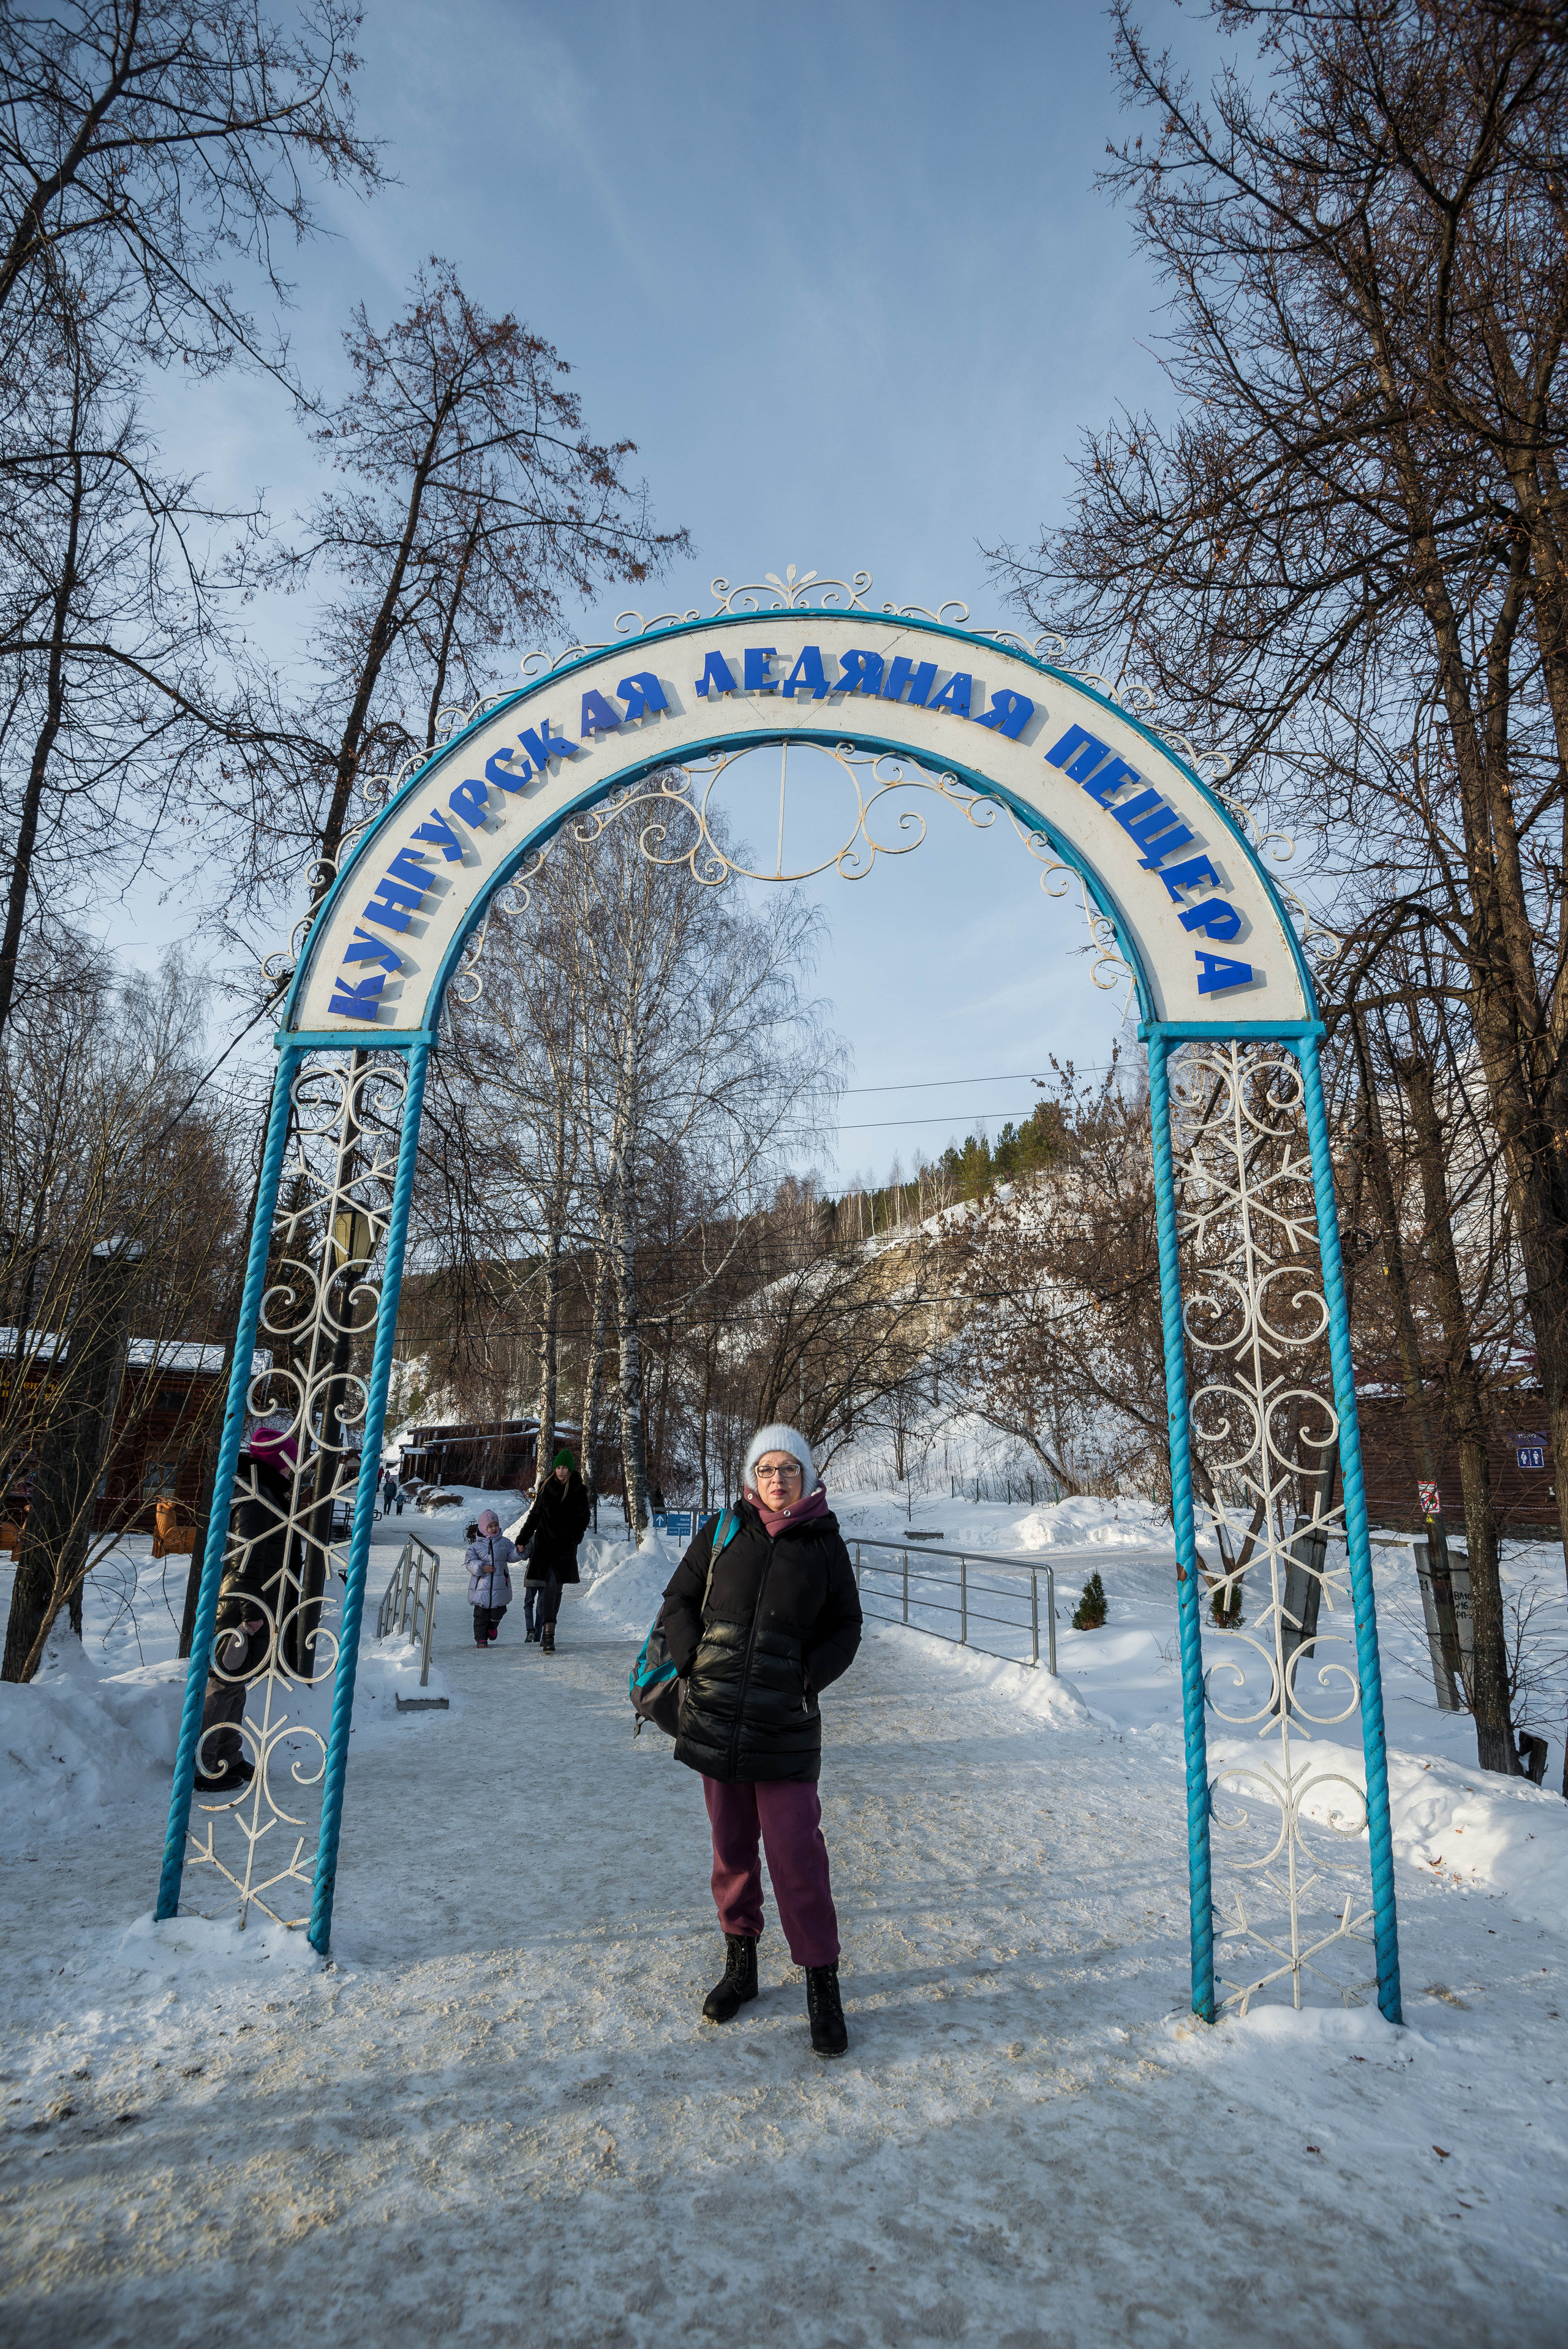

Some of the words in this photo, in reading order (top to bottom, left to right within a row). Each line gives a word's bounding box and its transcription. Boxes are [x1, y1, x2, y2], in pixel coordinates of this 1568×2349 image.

[327, 671, 669, 1020] КУНГУРСКАЯ
[695, 646, 1035, 740] ЛЕДЯНАЯ
[1044, 723, 1253, 995] ПЕЩЕРА
[1420, 1580, 1429, 1591] 21
